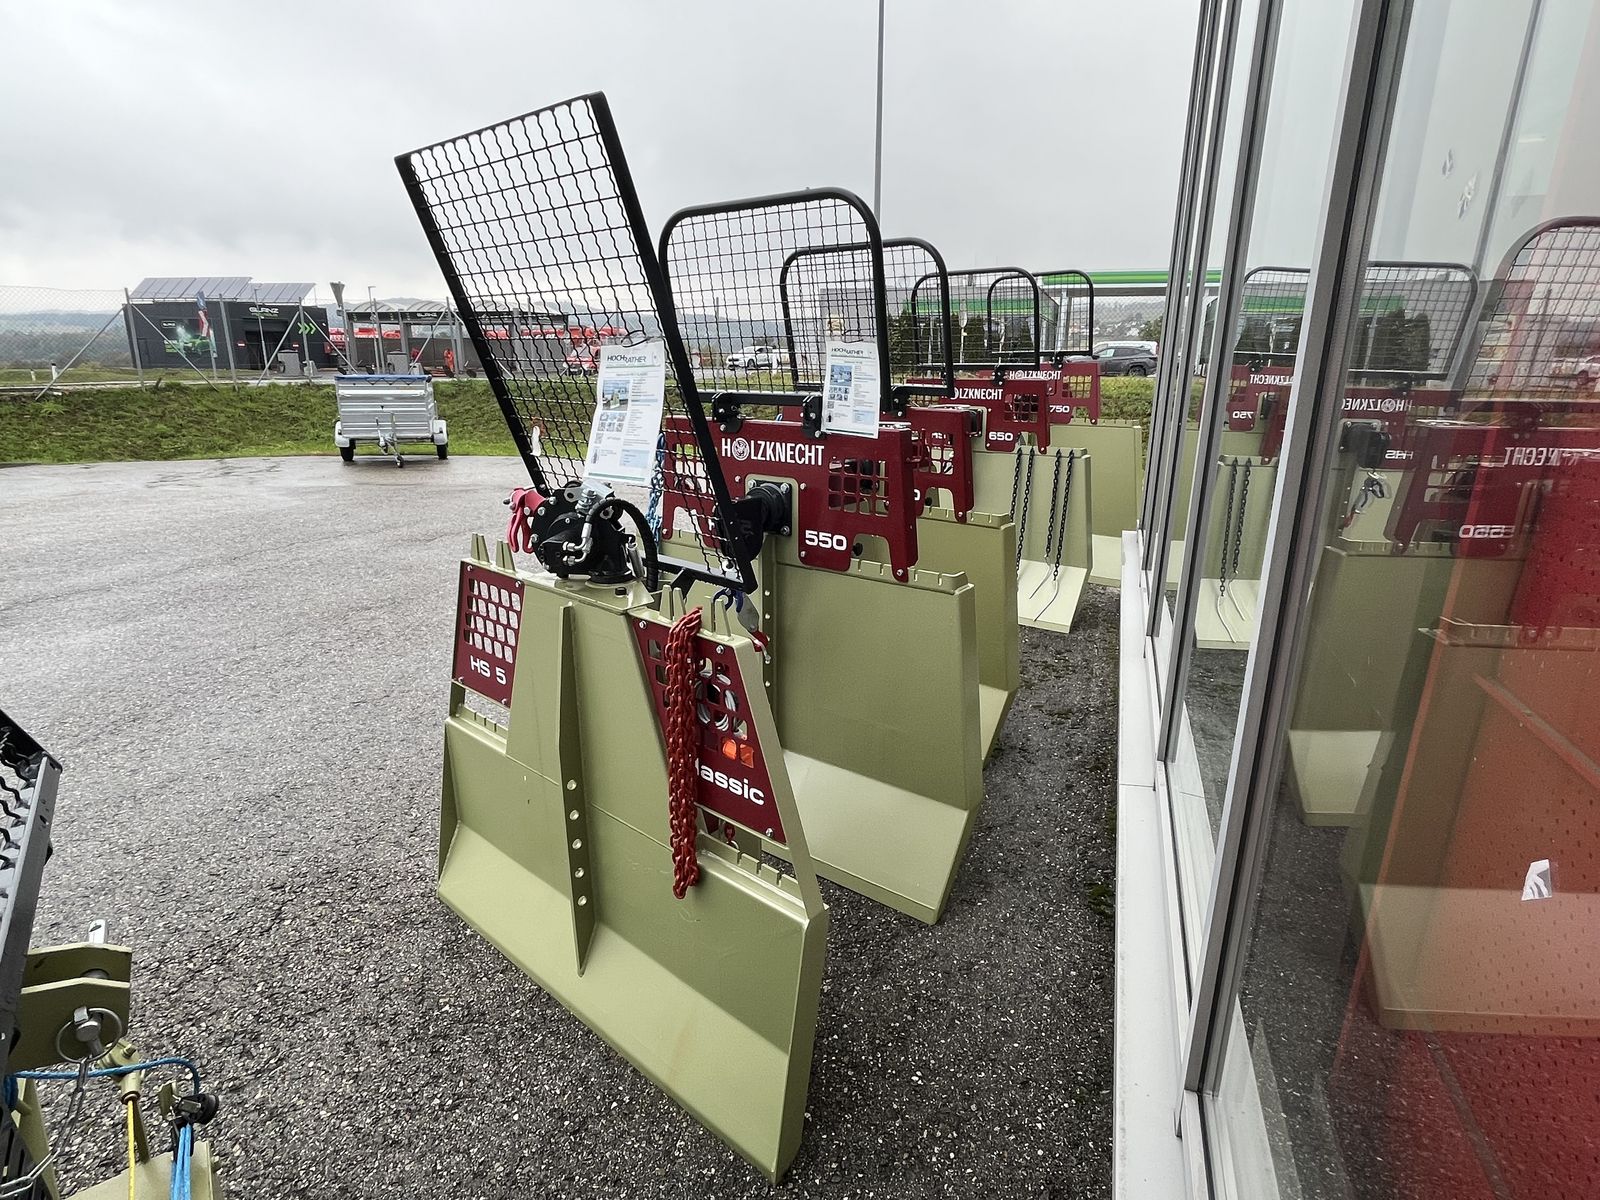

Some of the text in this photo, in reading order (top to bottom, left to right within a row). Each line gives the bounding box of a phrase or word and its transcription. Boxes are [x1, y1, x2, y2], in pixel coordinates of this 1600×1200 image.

[1049, 405, 1070, 413] 750
[988, 431, 1014, 441] 650
[721, 437, 825, 466] HOLZKNECHT
[805, 530, 847, 551] 550
[470, 655, 507, 685] HS 5
[695, 757, 765, 806] lassic
